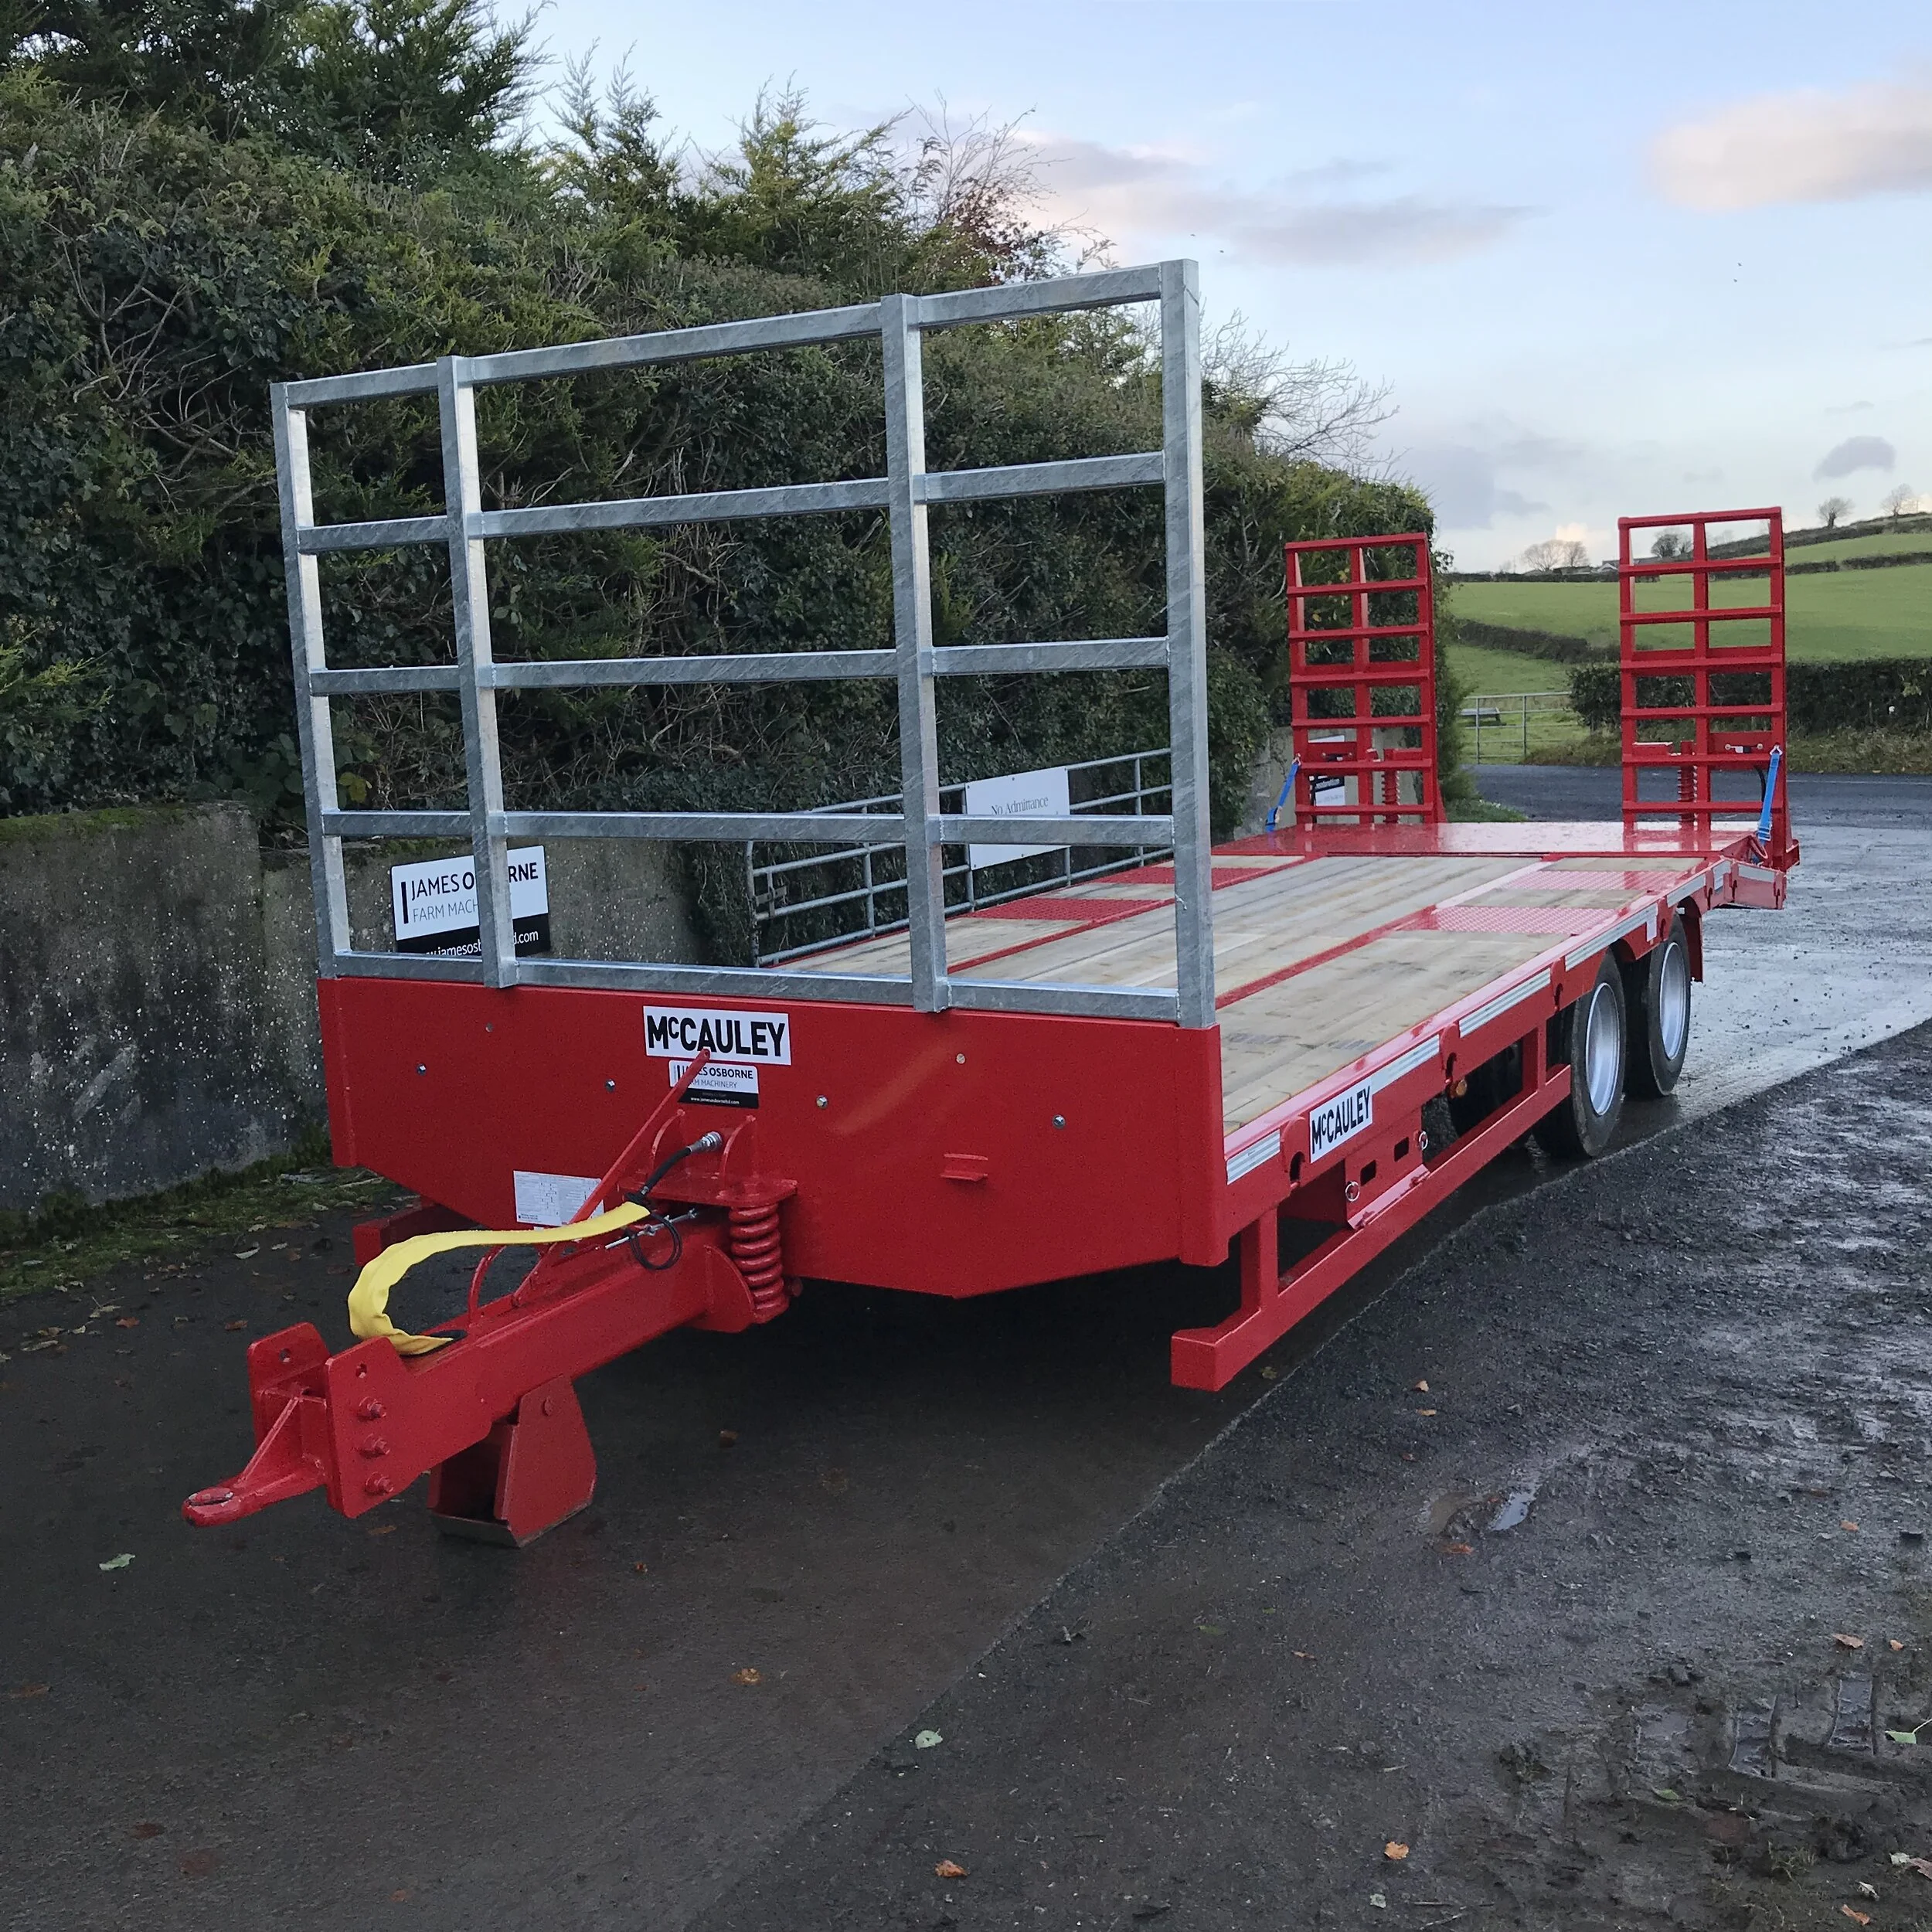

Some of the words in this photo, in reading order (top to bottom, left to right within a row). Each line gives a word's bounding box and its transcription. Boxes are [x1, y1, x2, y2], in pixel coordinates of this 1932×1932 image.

[992, 805, 1003, 815] No
[1005, 797, 1049, 815] Admittance
[411, 874, 460, 901] JAMES
[462, 862, 539, 890] ORNE
[413, 904, 444, 923] FARM
[647, 1015, 786, 1057] McCAULEY
[709, 1067, 753, 1080] OSBORNE
[701, 1079, 737, 1089] MACHINERY
[1311, 1085, 1371, 1155] McCAULEY
